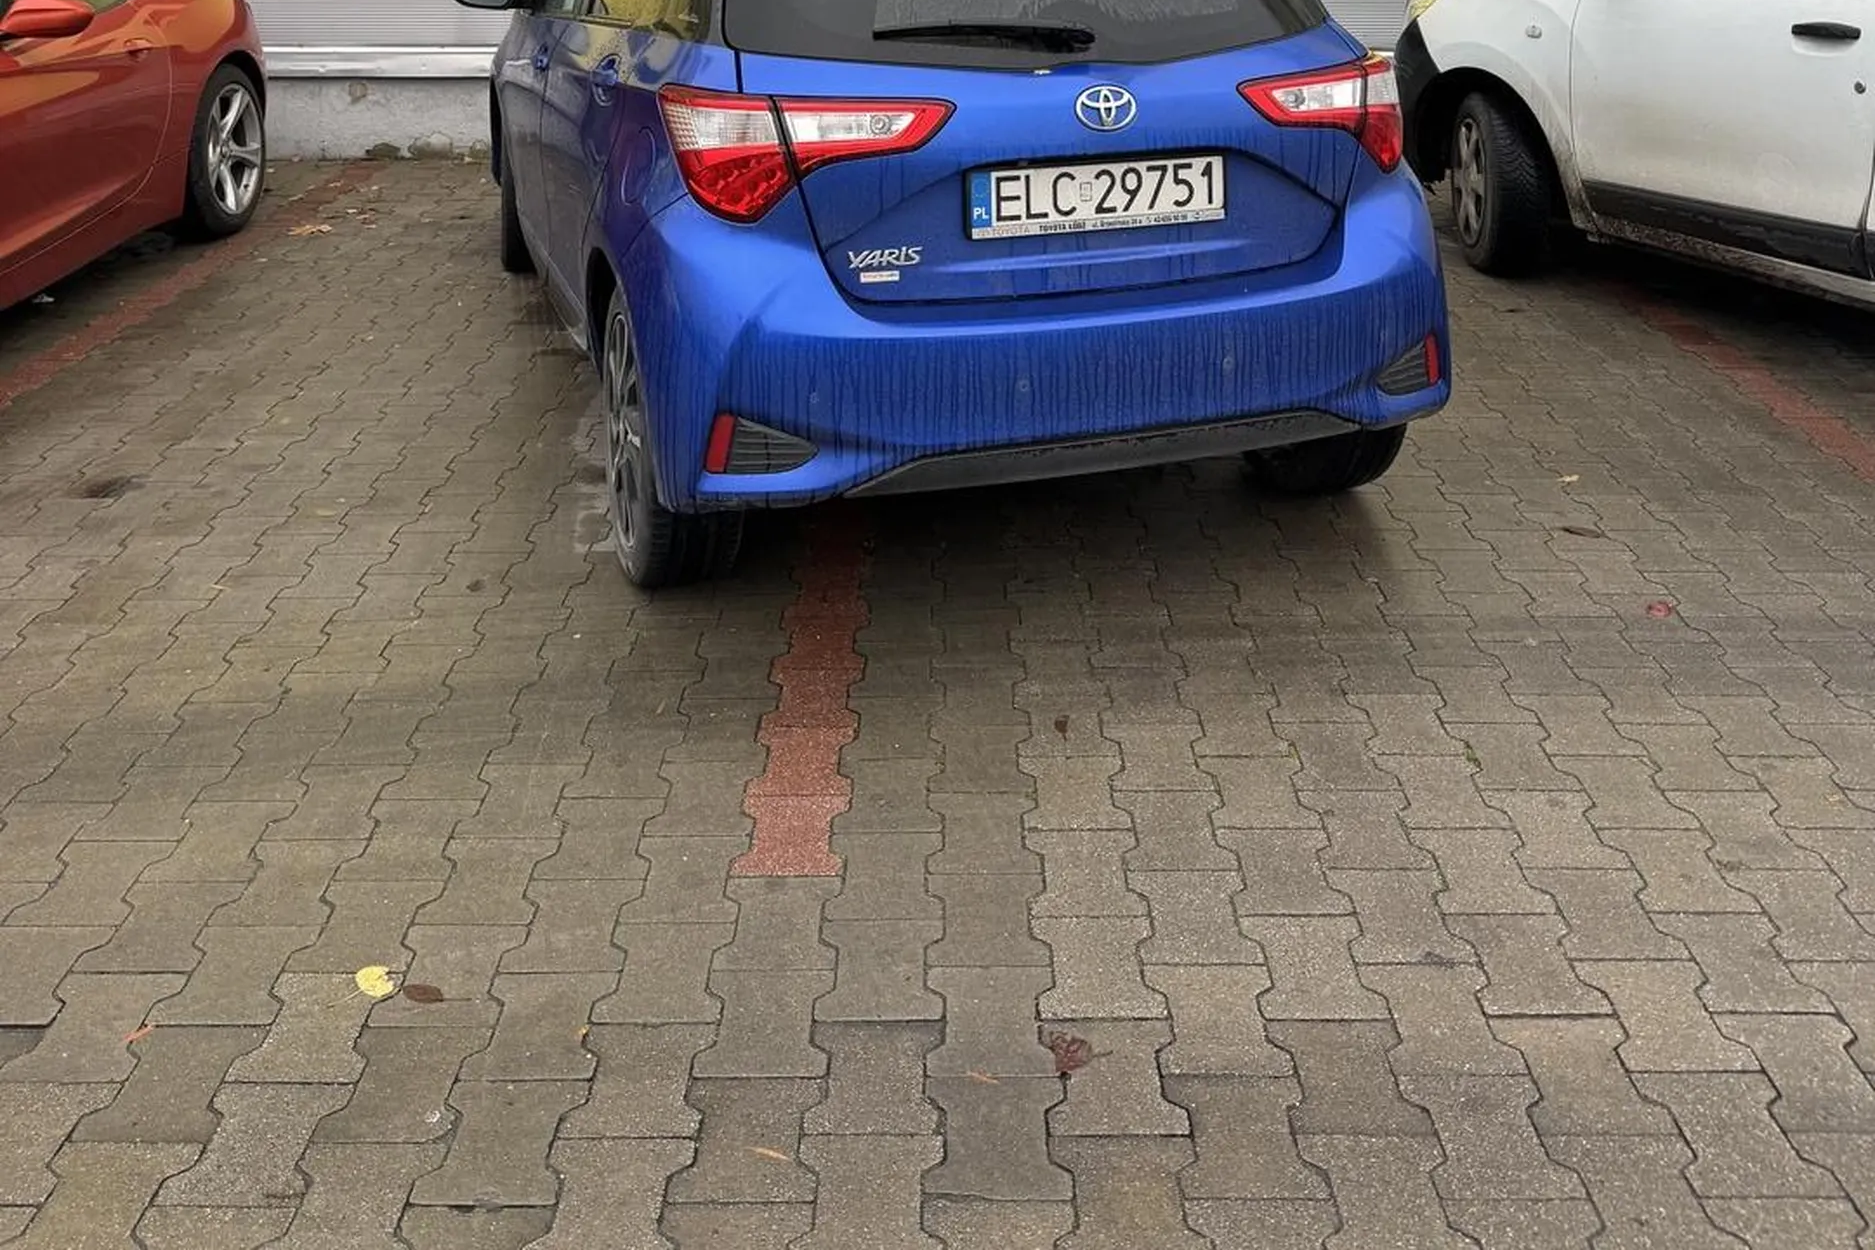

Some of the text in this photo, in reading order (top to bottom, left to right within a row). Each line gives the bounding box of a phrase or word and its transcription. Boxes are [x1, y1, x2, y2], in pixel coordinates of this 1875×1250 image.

[994, 160, 1215, 223] ELC 29751
[973, 207, 990, 220] PL
[847, 245, 924, 269] YARIS
